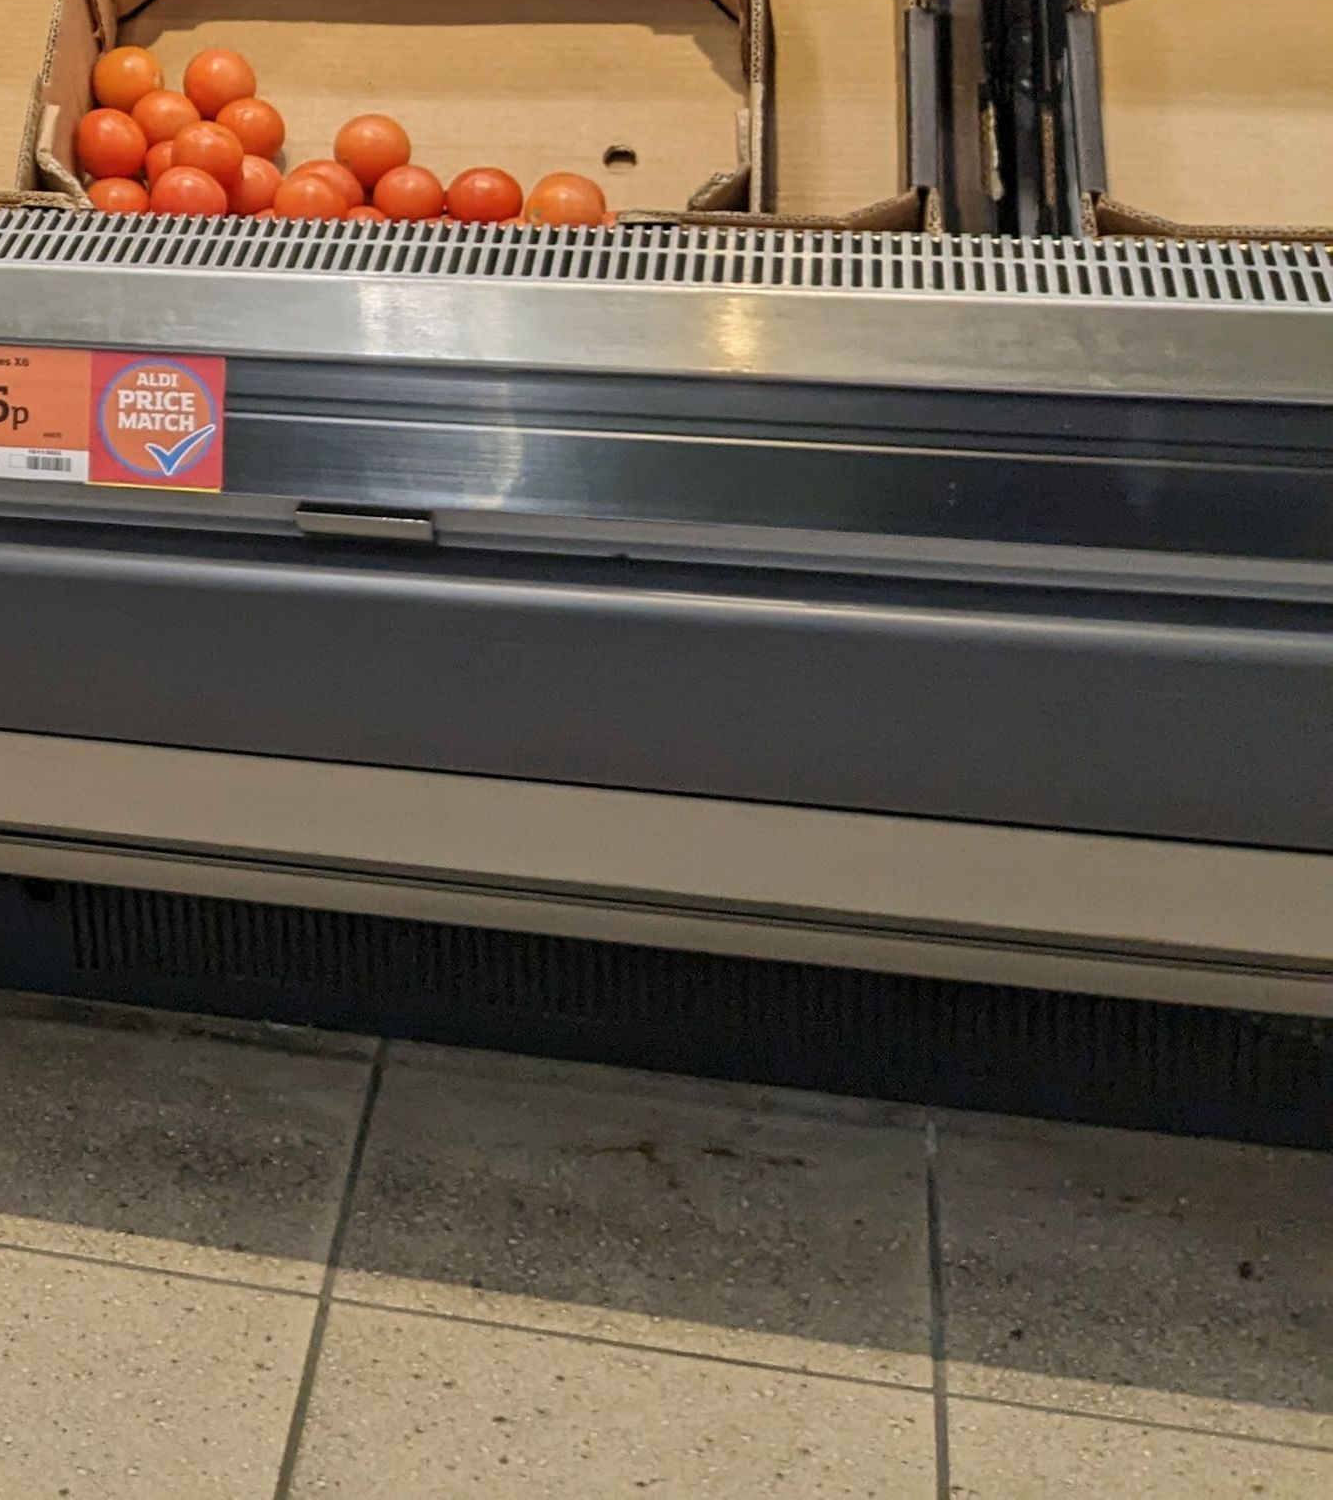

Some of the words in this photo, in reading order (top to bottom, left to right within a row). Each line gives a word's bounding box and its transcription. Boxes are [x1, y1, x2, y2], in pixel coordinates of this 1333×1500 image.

[14, 357, 29, 367] X6
[136, 372, 178, 387] ALDI
[118, 389, 196, 413] PRICE
[117, 413, 195, 432] MATCH
